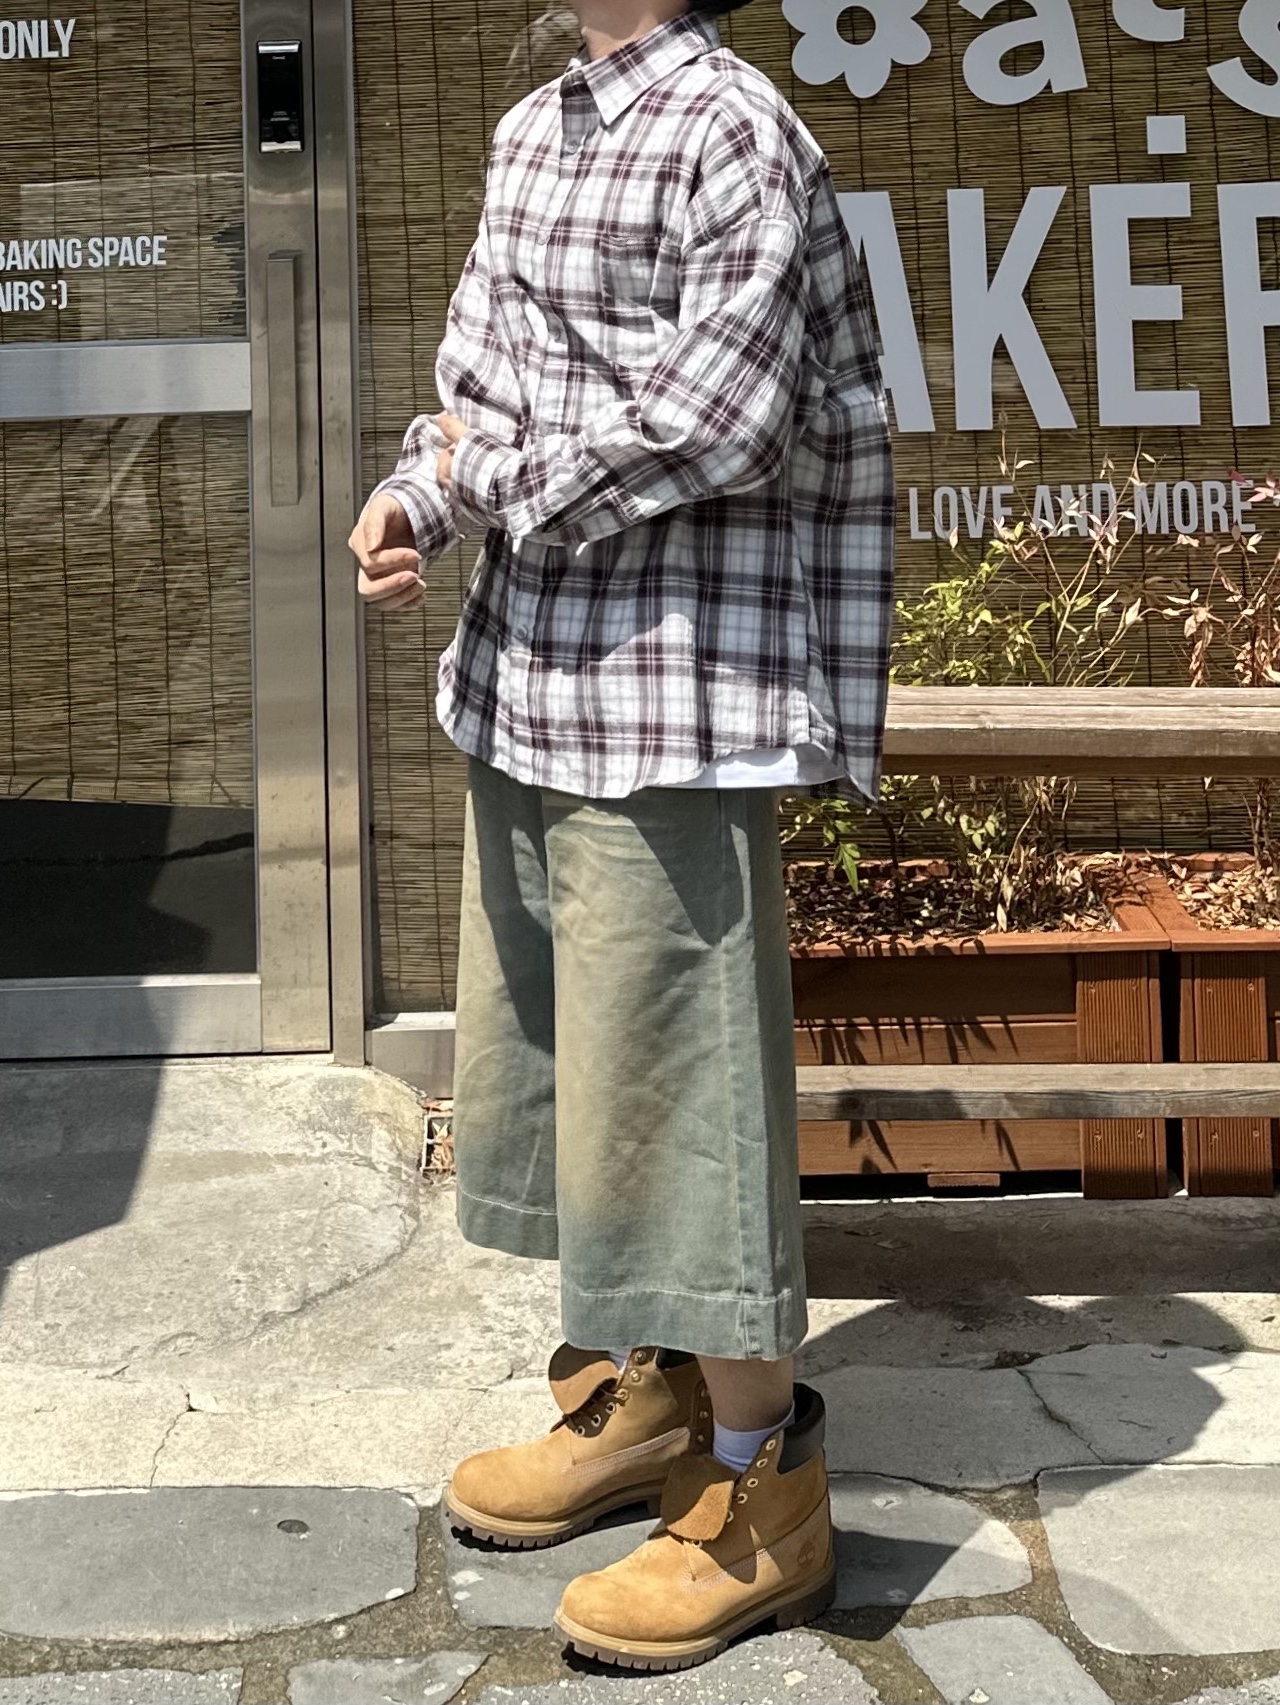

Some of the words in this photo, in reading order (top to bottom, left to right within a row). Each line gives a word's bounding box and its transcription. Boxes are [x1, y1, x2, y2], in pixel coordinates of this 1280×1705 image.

[0, 18, 76, 60] ONLY
[87, 235, 168, 268] SPACE
[908, 485, 1016, 540] LOVE
[1032, 484, 1118, 537] AND
[1133, 480, 1257, 535] MORE
